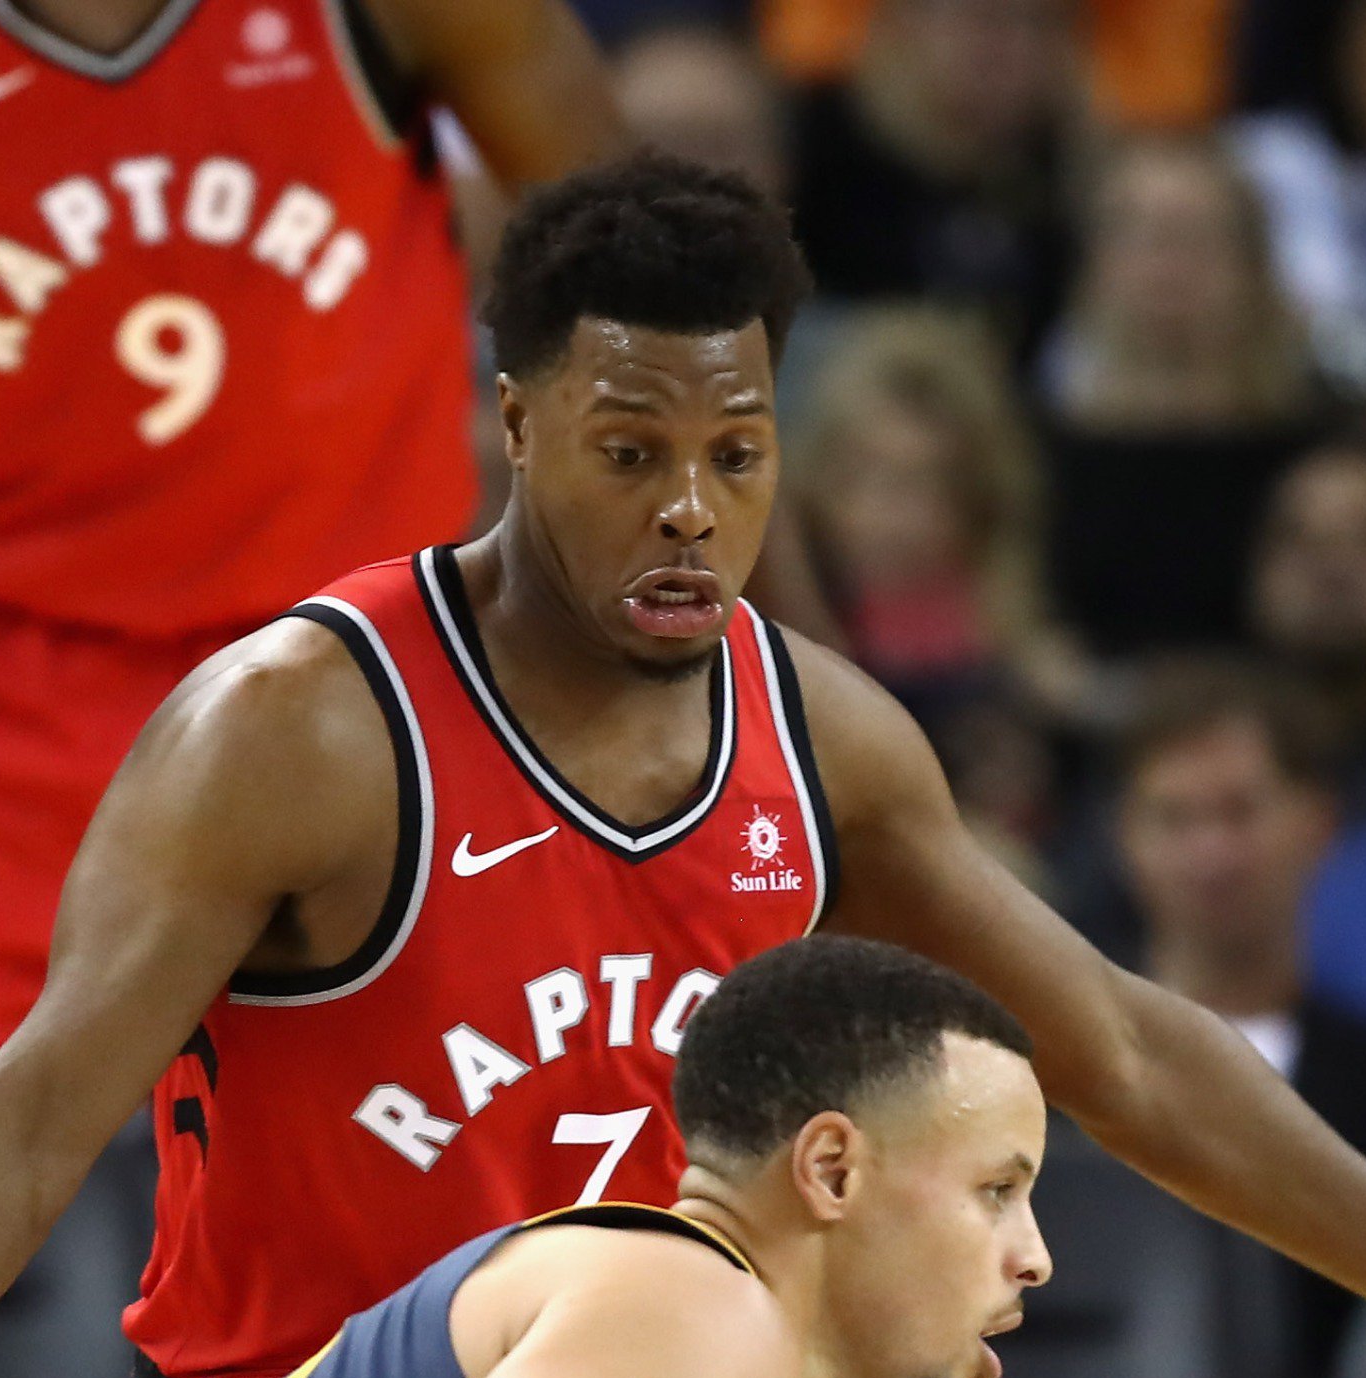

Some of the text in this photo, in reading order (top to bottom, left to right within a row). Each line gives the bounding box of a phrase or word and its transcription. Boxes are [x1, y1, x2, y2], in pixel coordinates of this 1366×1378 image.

[114, 293, 227, 448] 9
[731, 869, 803, 892] Sun Life
[352, 953, 721, 1172] RAPTO
[551, 1106, 653, 1206] 7
